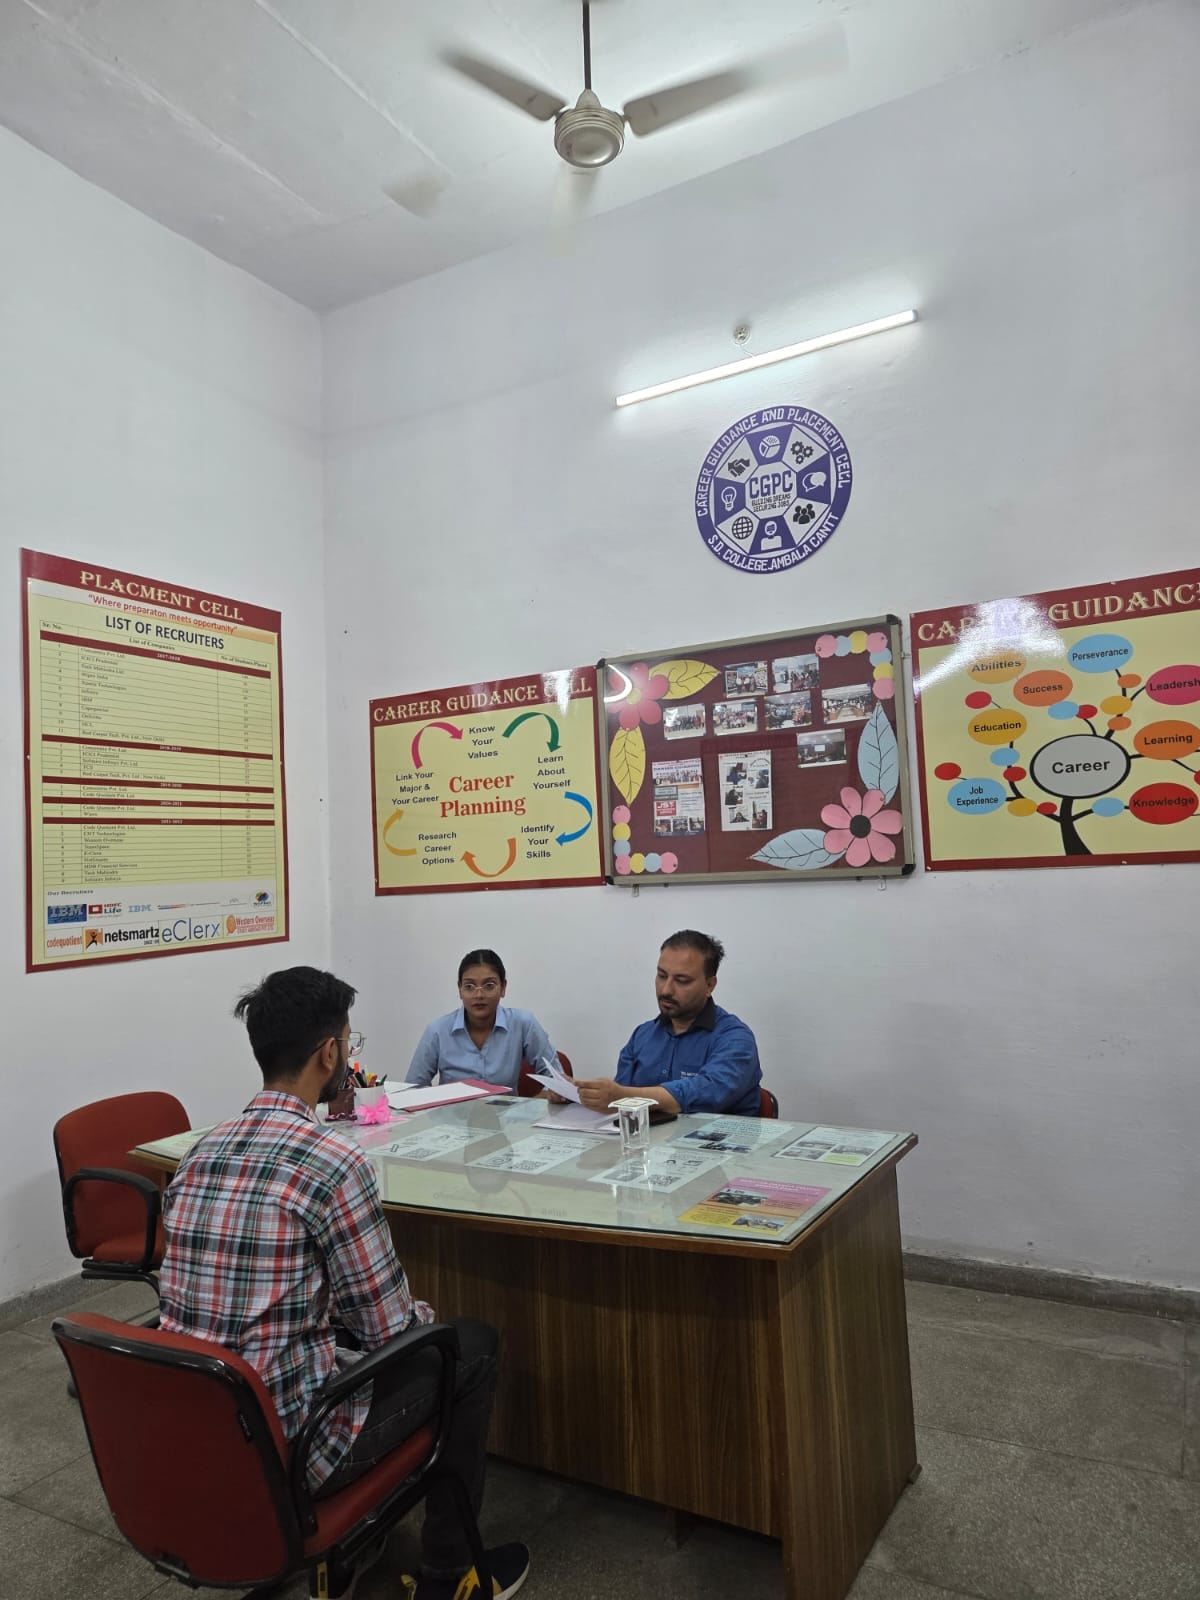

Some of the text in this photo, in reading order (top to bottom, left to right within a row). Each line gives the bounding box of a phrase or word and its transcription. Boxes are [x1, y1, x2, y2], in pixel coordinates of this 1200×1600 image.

[696, 407, 850, 517] CAREER GUIDANCE AND PLACEMENT CELL
[749, 470, 793, 499] CGPC
[708, 534, 724, 555] S.D.
[811, 511, 839, 548] CANTT
[80, 570, 244, 621] PLACMENT CELL
[1047, 582, 1200, 622] GUIDANC
[123, 603, 168, 618] preparaton
[169, 612, 192, 623] meets
[105, 615, 224, 650] LIST OF RECRUITERS
[1072, 647, 1129, 661] Perseverance
[971, 659, 1022, 673] Abilities
[1023, 683, 1063, 695] Success
[373, 699, 441, 722] CAREER
[446, 684, 538, 710] GUIDANCE
[469, 724, 496, 734] Know
[973, 721, 1022, 733] Education
[471, 737, 493, 747] Your
[1144, 733, 1193, 746] Learning
[467, 750, 498, 759] Values
[537, 754, 564, 764] Learn
[537, 767, 565, 777] About
[1051, 759, 1111, 774] Career
[395, 771, 434, 781] Link Your
[399, 783, 431, 794] Major &
[448, 774, 515, 794] Career
[532, 779, 571, 790] Yourself
[969, 786, 984, 795] Job
[391, 795, 439, 806] Your Career
[440, 796, 526, 817] Planning
[956, 796, 998, 807] Experience
[1132, 796, 1195, 809] Knowledge
[521, 824, 555, 834] Identify
[418, 831, 457, 841] Research
[527, 837, 549, 846] Your
[424, 844, 452, 853] Career
[526, 850, 551, 859] Skills
[422, 856, 455, 866] Options
[50, 905, 84, 918] IBM
[128, 904, 153, 913] IBM
[104, 926, 160, 943] netsmartz
[161, 917, 220, 943] eClerx
